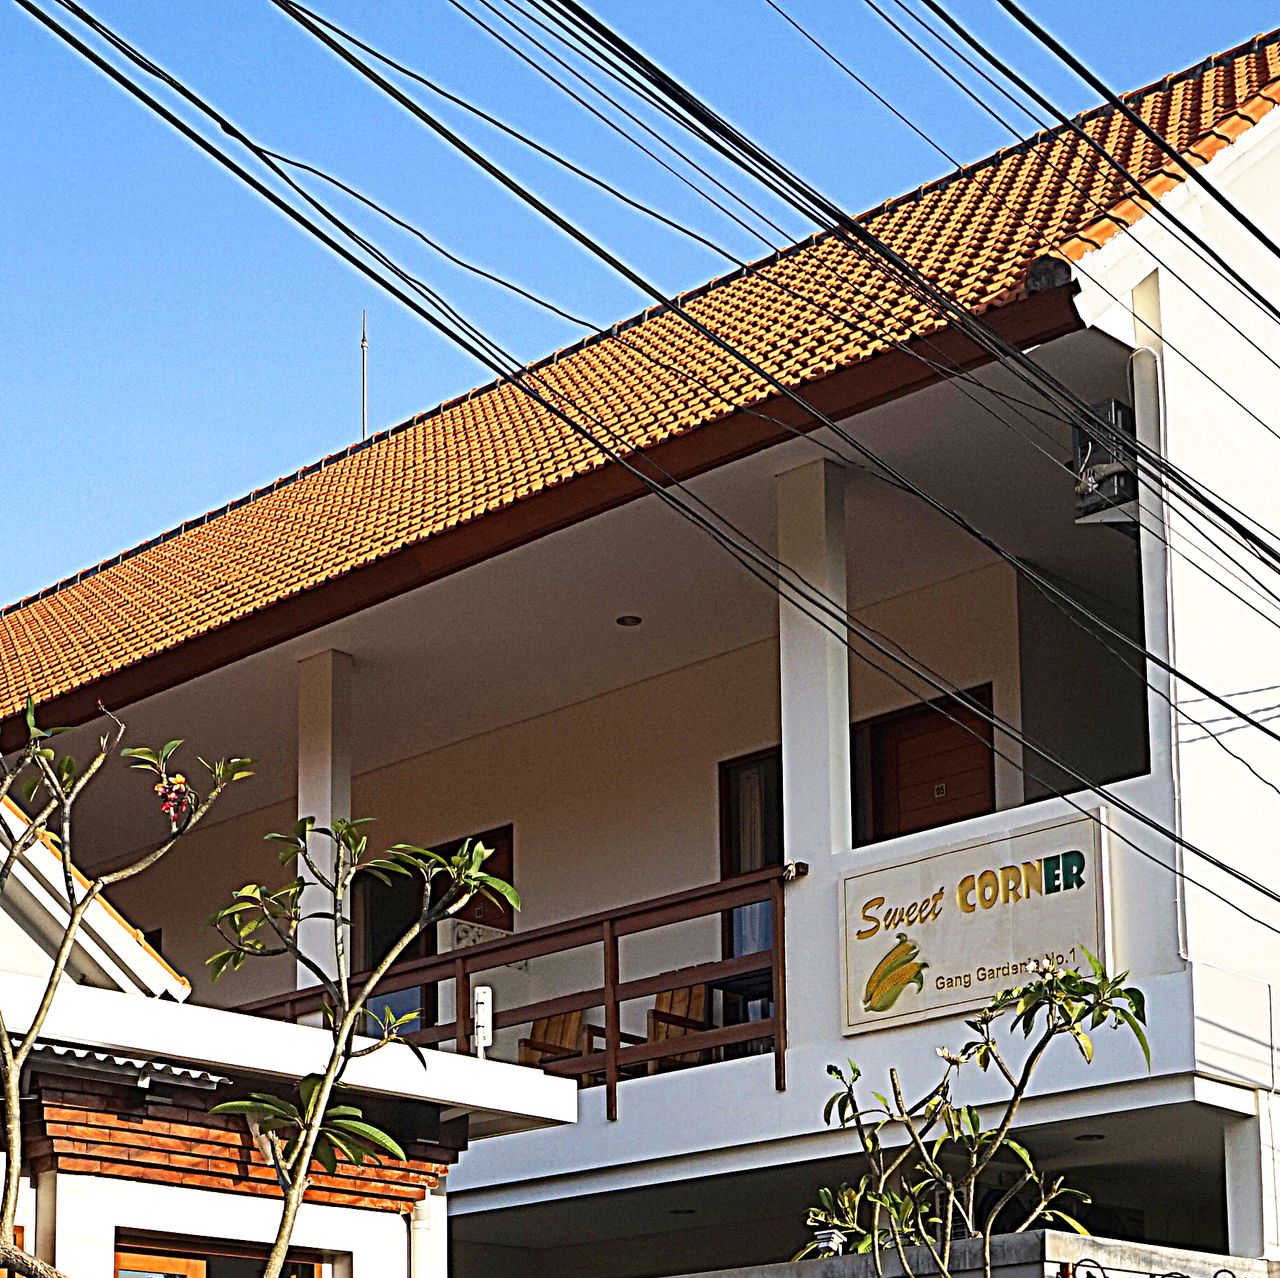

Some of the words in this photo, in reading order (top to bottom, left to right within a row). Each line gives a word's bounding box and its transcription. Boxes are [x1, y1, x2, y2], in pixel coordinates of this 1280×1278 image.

[856, 886, 944, 939] Sweet
[956, 850, 1086, 913] CORNER
[935, 974, 972, 990] Gang
